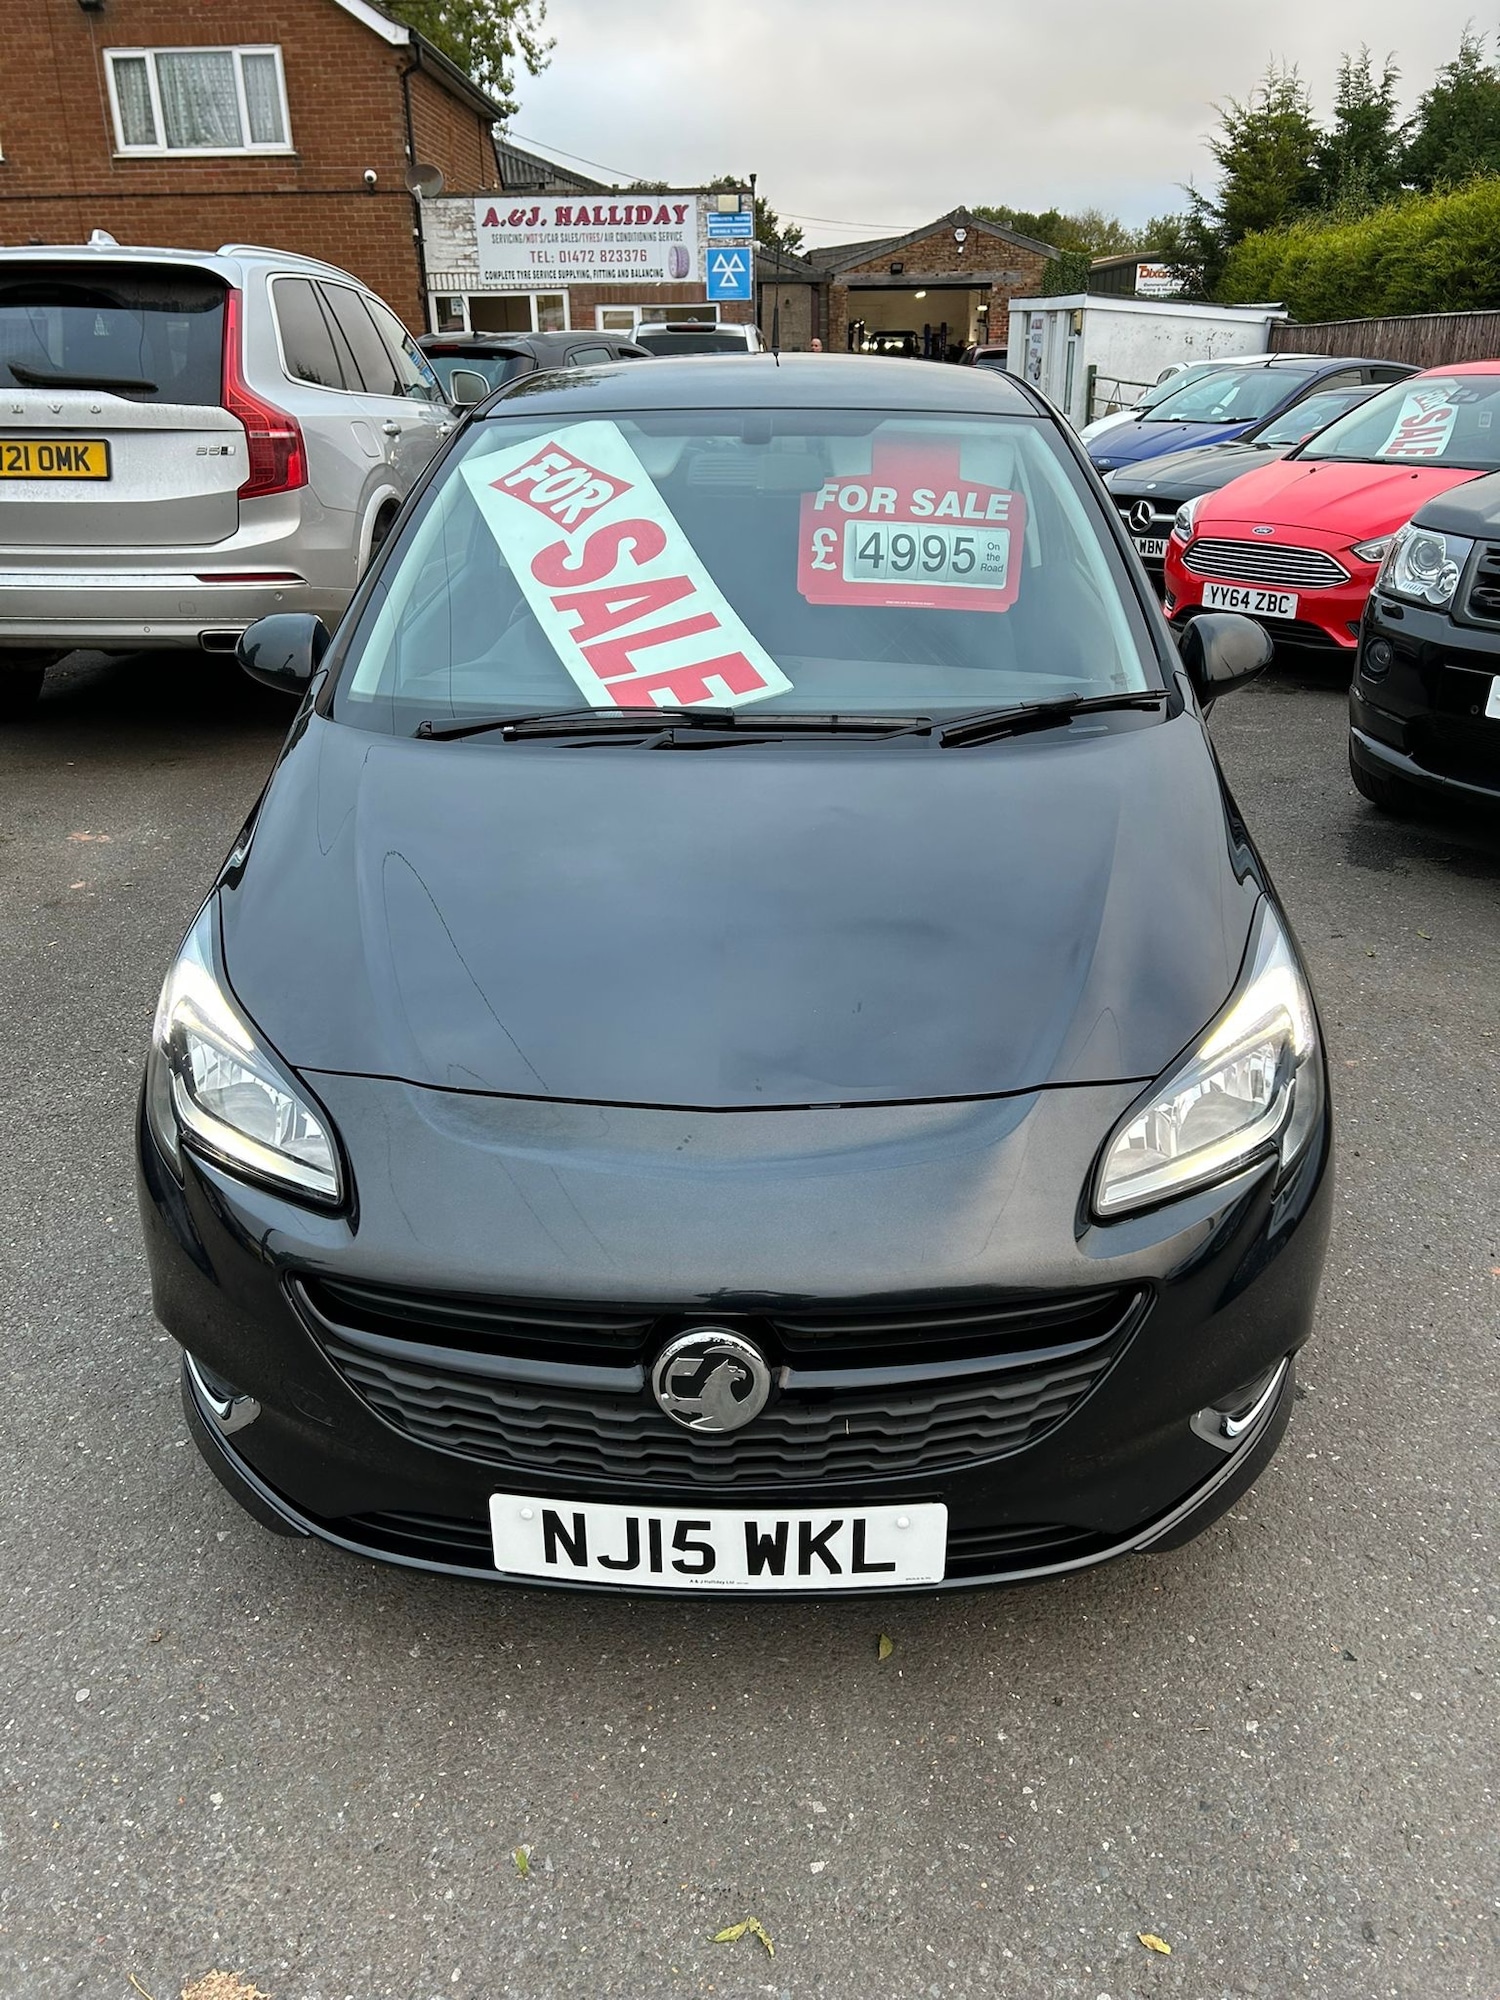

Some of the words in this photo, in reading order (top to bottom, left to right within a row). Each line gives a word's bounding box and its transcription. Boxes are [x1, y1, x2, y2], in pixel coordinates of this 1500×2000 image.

[554, 204, 690, 226] HALLIDAY
[615, 231, 657, 242] CONDITIONING
[658, 231, 683, 242] SERVICE
[530, 250, 555, 263] TEL:
[559, 250, 595, 263] 01472
[600, 249, 648, 262] 823376
[484, 270, 515, 280] COMPLETE
[516, 270, 531, 280] TYRE
[532, 270, 557, 280] SERVICE
[558, 269, 592, 281] SUPPLYING,
[593, 269, 616, 279] FITTING
[617, 269, 629, 278] AND
[631, 268, 664, 278] BALANCING
[1385, 408, 1453, 455] SALE
[0, 445, 31, 472] 21
[38, 445, 91, 472] OMK
[503, 452, 615, 525] FOR
[814, 483, 898, 514] FOR
[910, 488, 1012, 521] SALE
[810, 527, 838, 571] £
[858, 531, 976, 574] 4995
[986, 552, 1001, 562] the
[987, 541, 1001, 551] On
[1139, 539, 1164, 555] WBN
[980, 563, 1004, 573] Road
[1211, 585, 1251, 609] YY64
[1254, 592, 1290, 615] ZBC
[530, 518, 768, 714] SALE
[541, 1508, 716, 1576] NJ15
[744, 1518, 896, 1576] WKL
